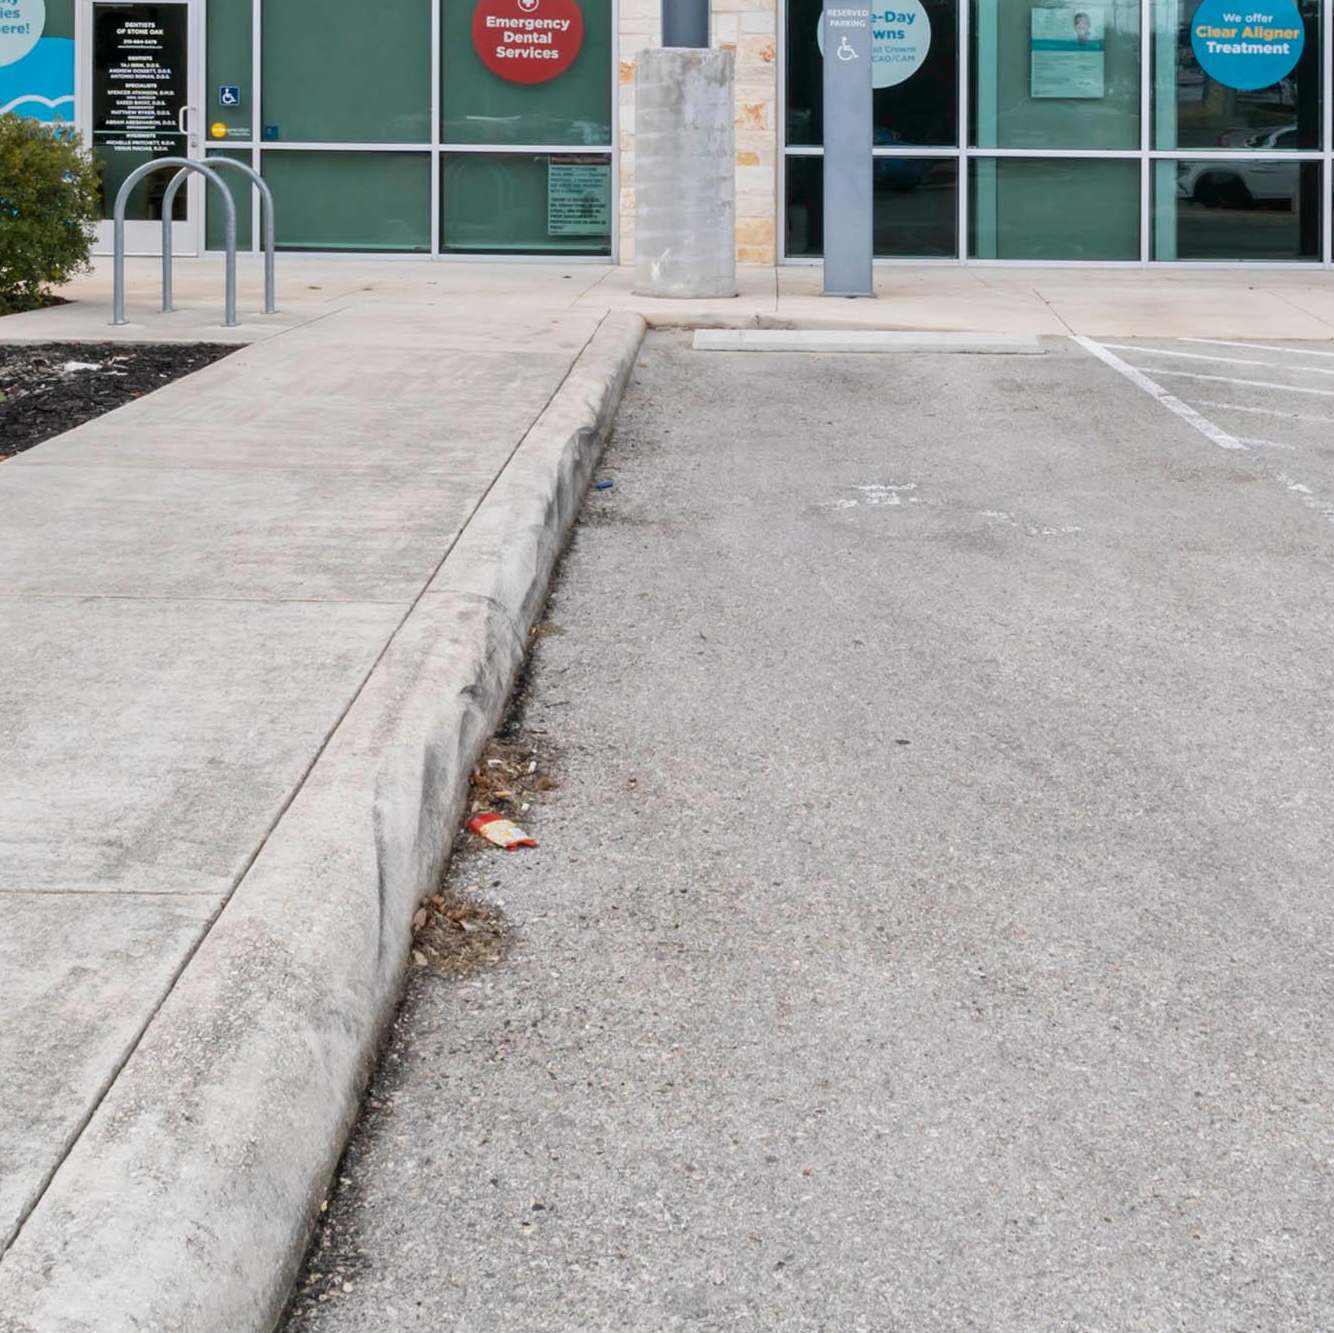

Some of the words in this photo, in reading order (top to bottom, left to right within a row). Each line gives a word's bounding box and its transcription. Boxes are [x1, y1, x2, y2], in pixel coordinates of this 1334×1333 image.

[827, 9, 869, 17] RESERVED
[1223, 13, 1242, 23] We
[1245, 13, 1273, 24] offer
[486, 15, 571, 31] Emergency
[830, 19, 867, 27] PARKING
[503, 31, 553, 44] Dental
[1195, 25, 1237, 38] Clear
[1241, 25, 1301, 41] Aligner
[496, 46, 560, 59] Services
[885, 46, 917, 54] Crowns
[1206, 40, 1291, 55] Treatment
